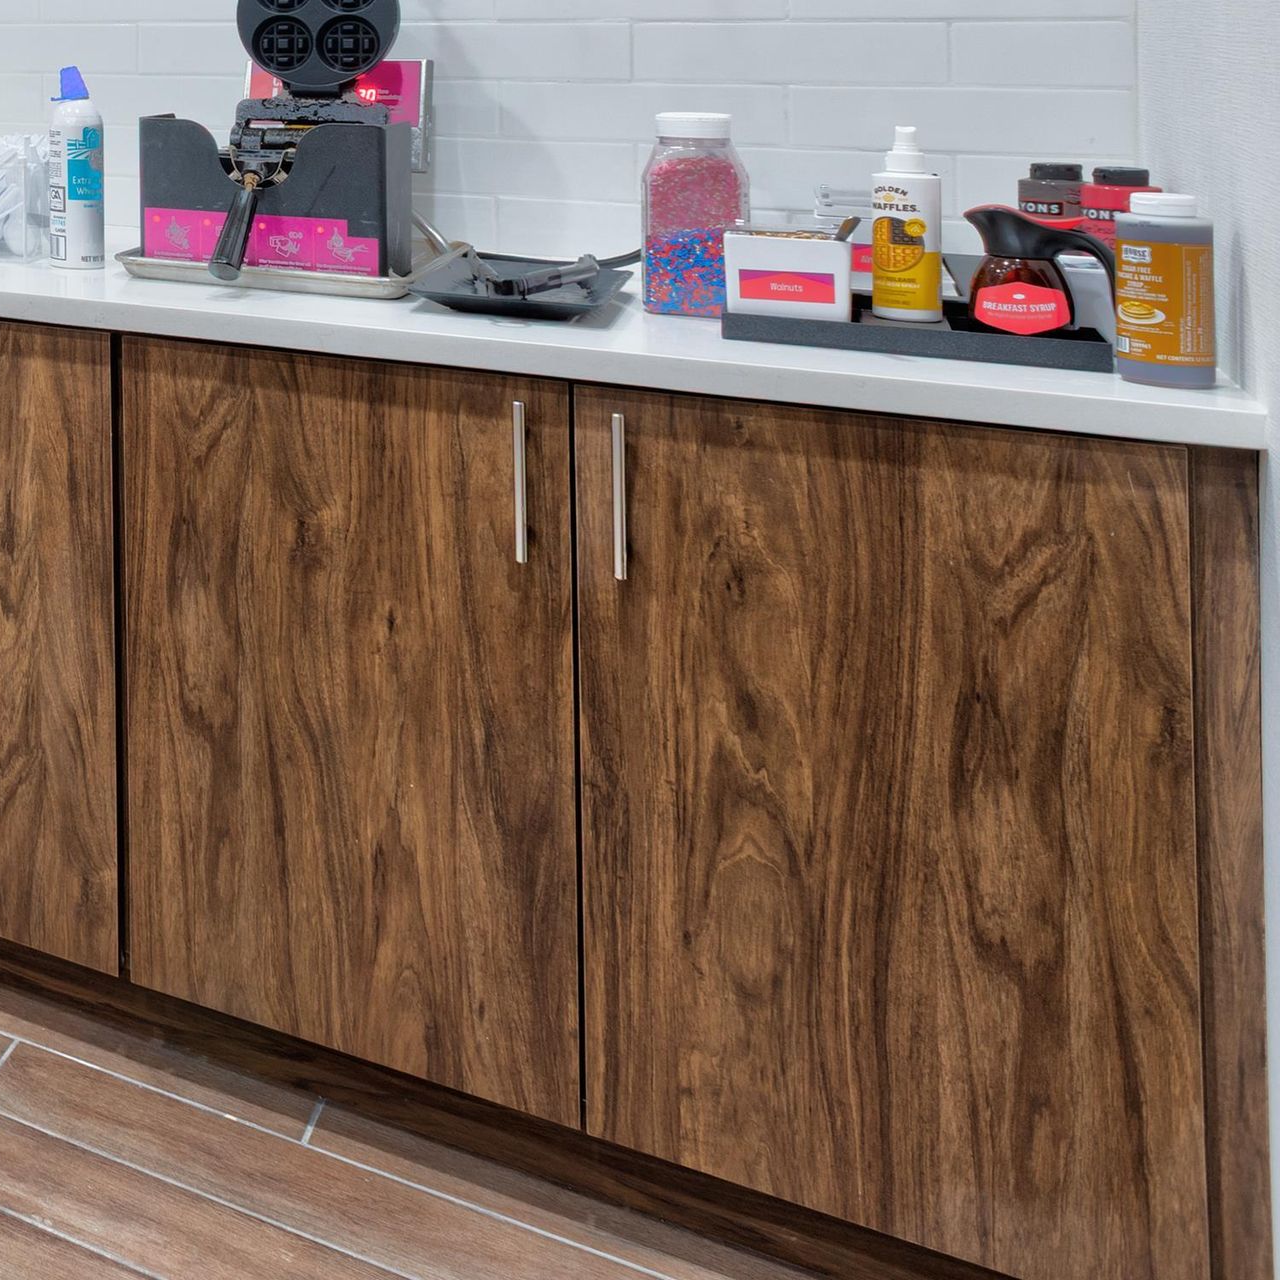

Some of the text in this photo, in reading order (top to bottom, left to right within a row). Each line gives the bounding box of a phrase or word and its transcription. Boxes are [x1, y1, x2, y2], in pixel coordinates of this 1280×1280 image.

[1020, 201, 1060, 214] YONS
[1140, 274, 1163, 283] WAFFLE
[770, 282, 804, 292] Walnuts
[982, 300, 1056, 312] BREAKFAST SYRUP
